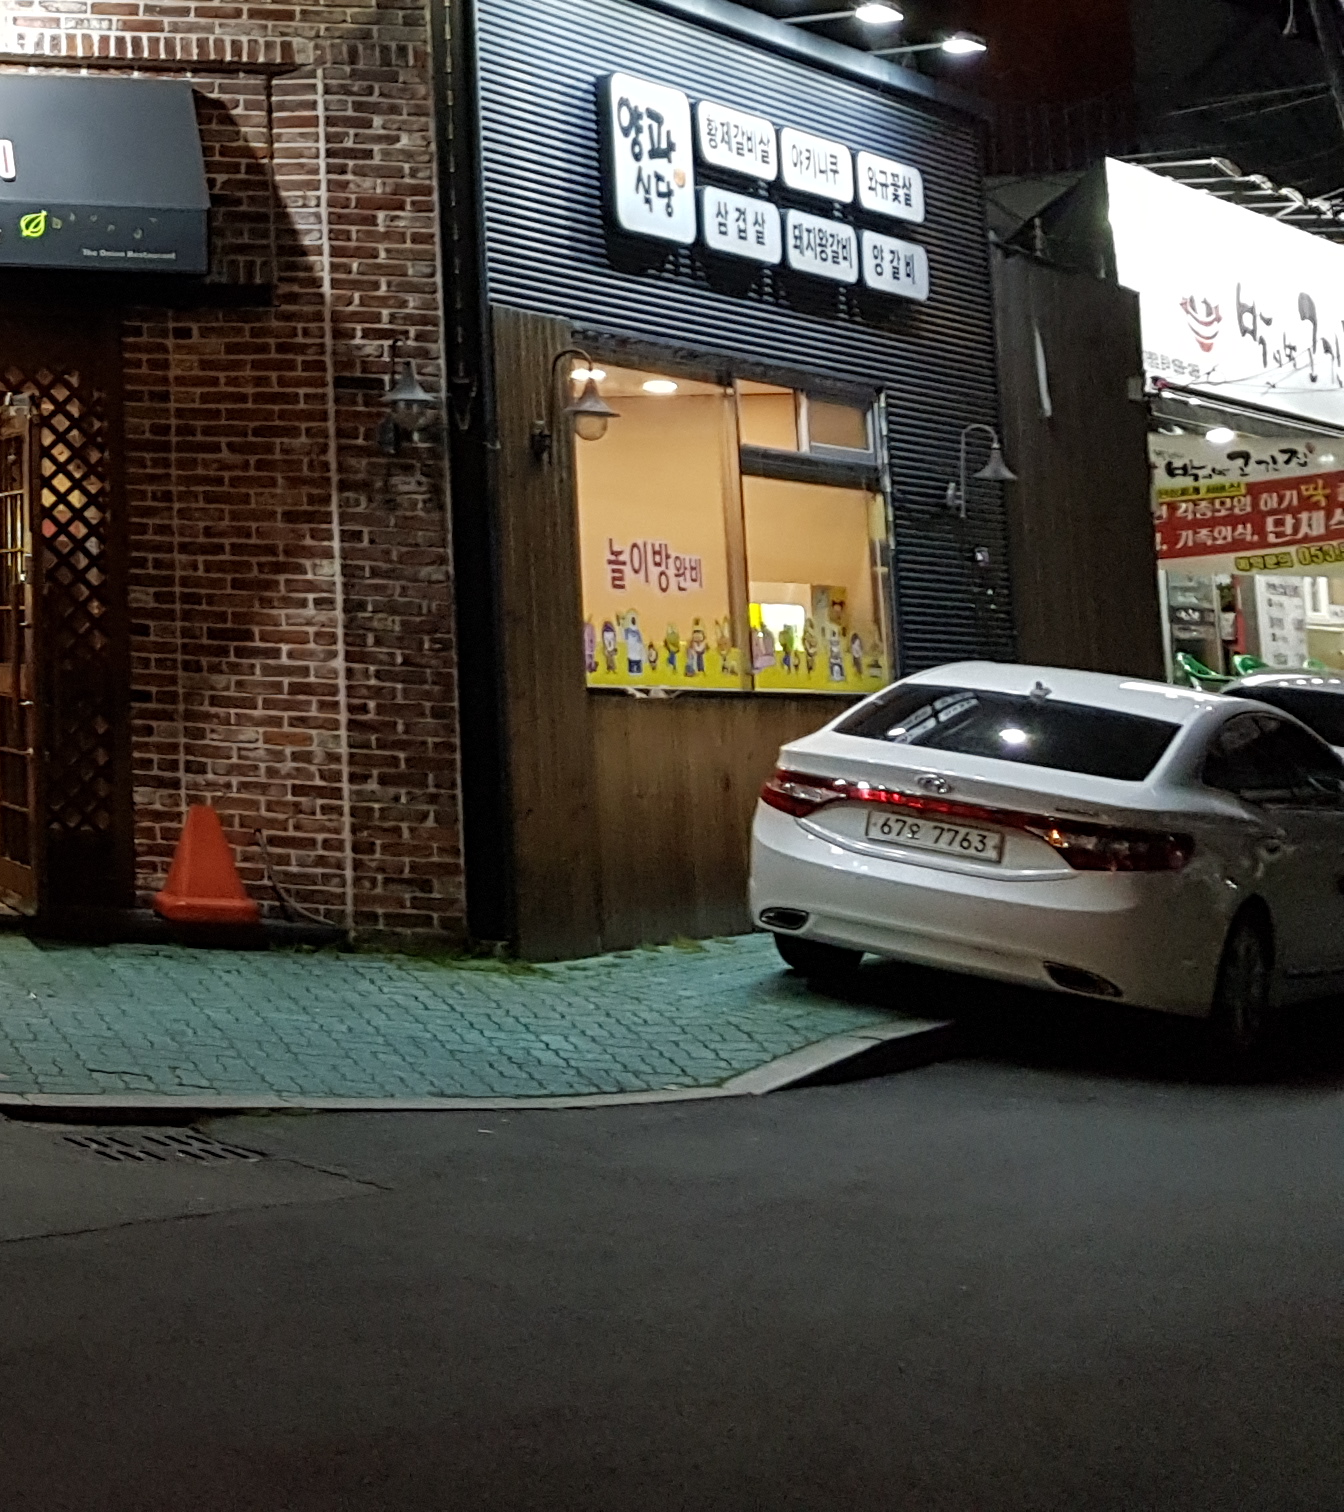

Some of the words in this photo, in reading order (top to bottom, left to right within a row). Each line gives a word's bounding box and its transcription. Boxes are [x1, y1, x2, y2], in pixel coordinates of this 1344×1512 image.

[617, 95, 677, 165] 양파
[705, 117, 771, 165] 황제갈비살
[790, 142, 841, 186] 야키니쿠
[634, 165, 675, 218] 식당
[866, 166, 913, 209] 와규꽃살
[791, 221, 853, 269] 돼지왕갈비
[1175, 495, 1252, 520] 각종모임
[1259, 489, 1299, 511] 하기
[932, 825, 988, 853] 7763
